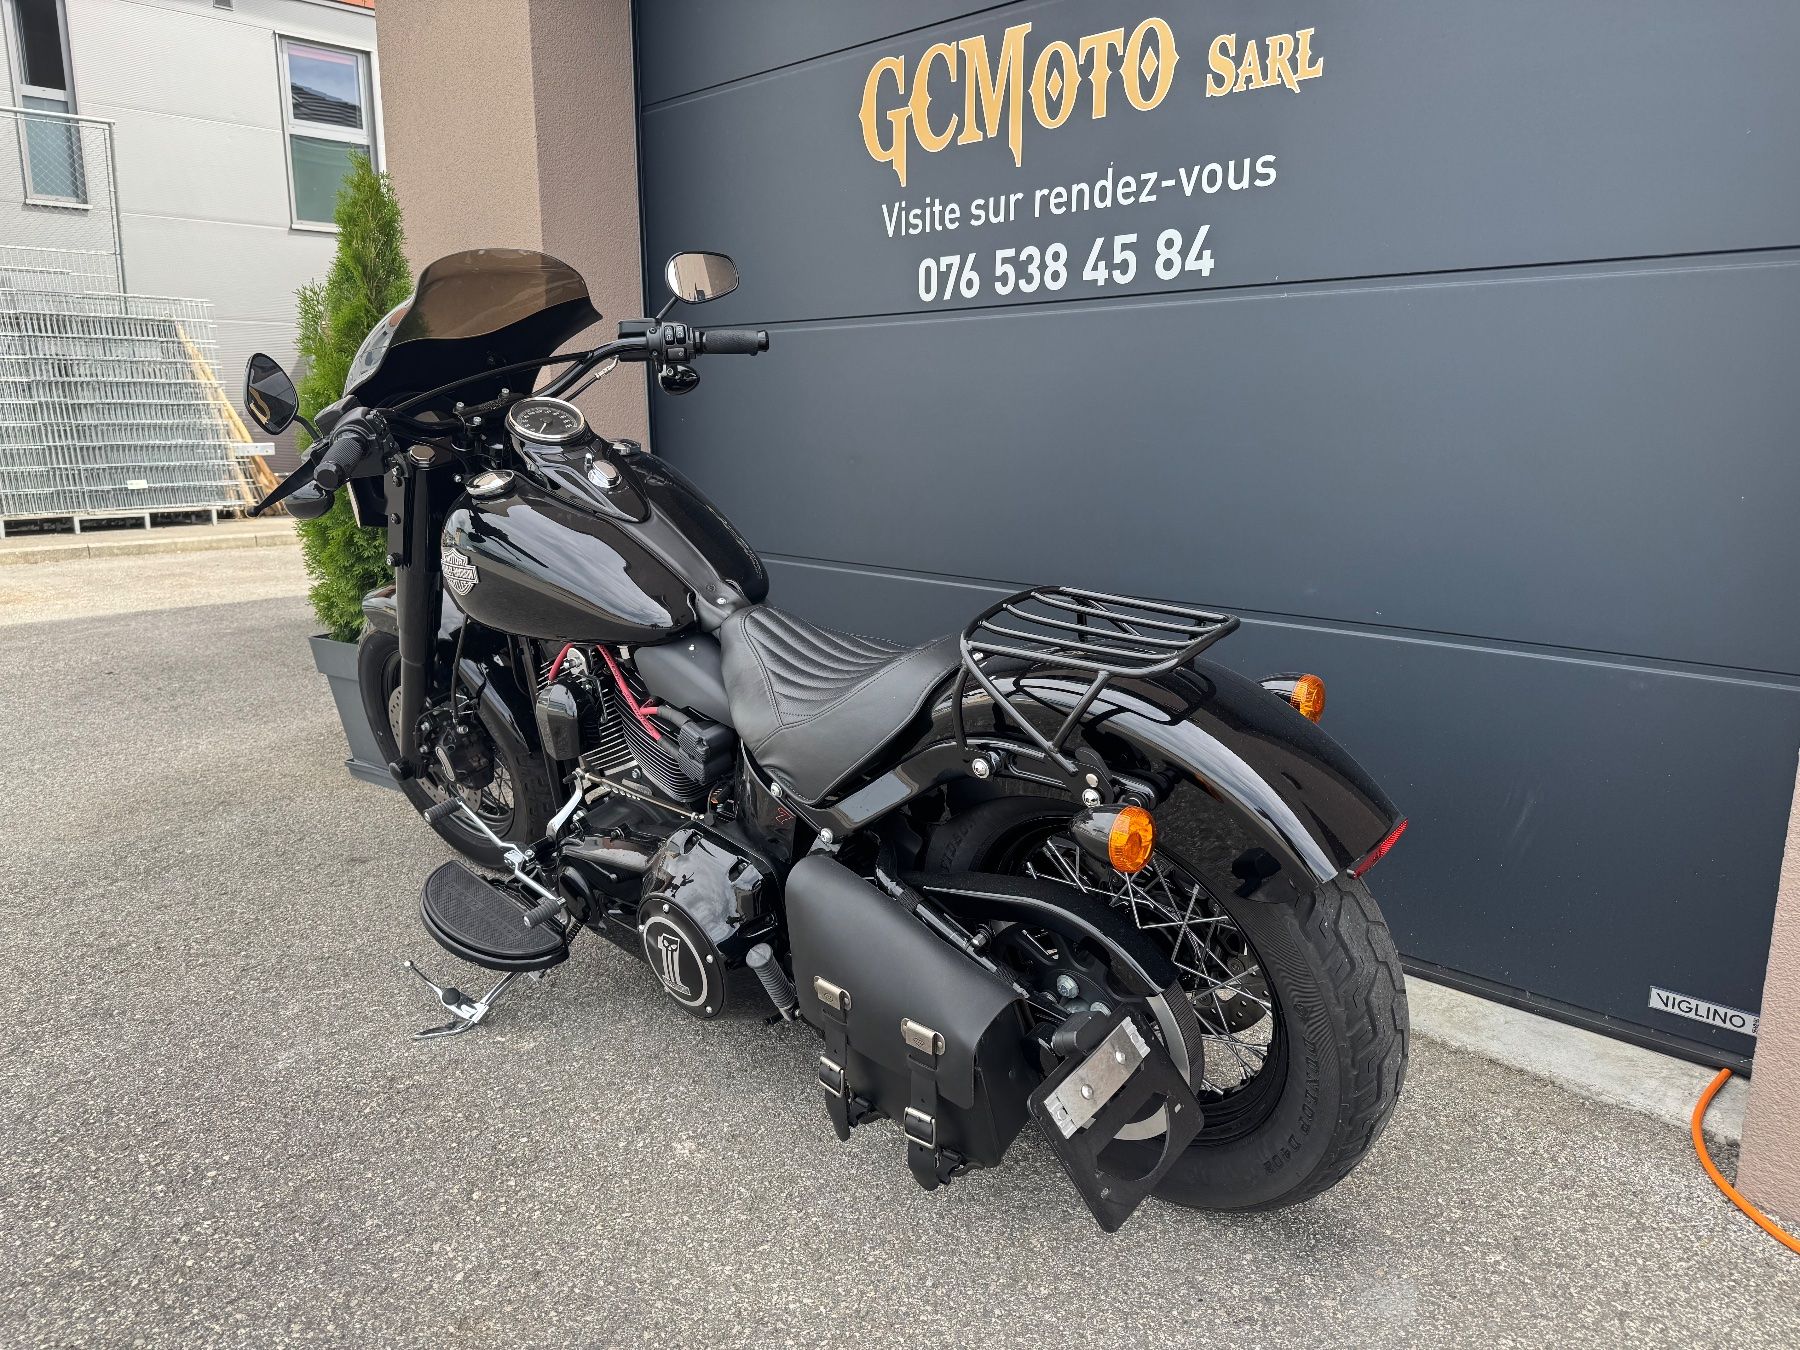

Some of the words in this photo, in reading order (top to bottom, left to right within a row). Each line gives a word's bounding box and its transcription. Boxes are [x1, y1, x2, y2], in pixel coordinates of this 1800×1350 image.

[1206, 27, 1324, 98] SARL
[881, 197, 961, 238] Visite
[970, 192, 1024, 227] sur
[1034, 154, 1277, 218] rendez-vous
[918, 252, 980, 302] 076
[994, 242, 1068, 295] 538
[1082, 233, 1138, 286] 45
[1155, 225, 1215, 281] 84
[1656, 991, 1746, 1029] VIGLINO
